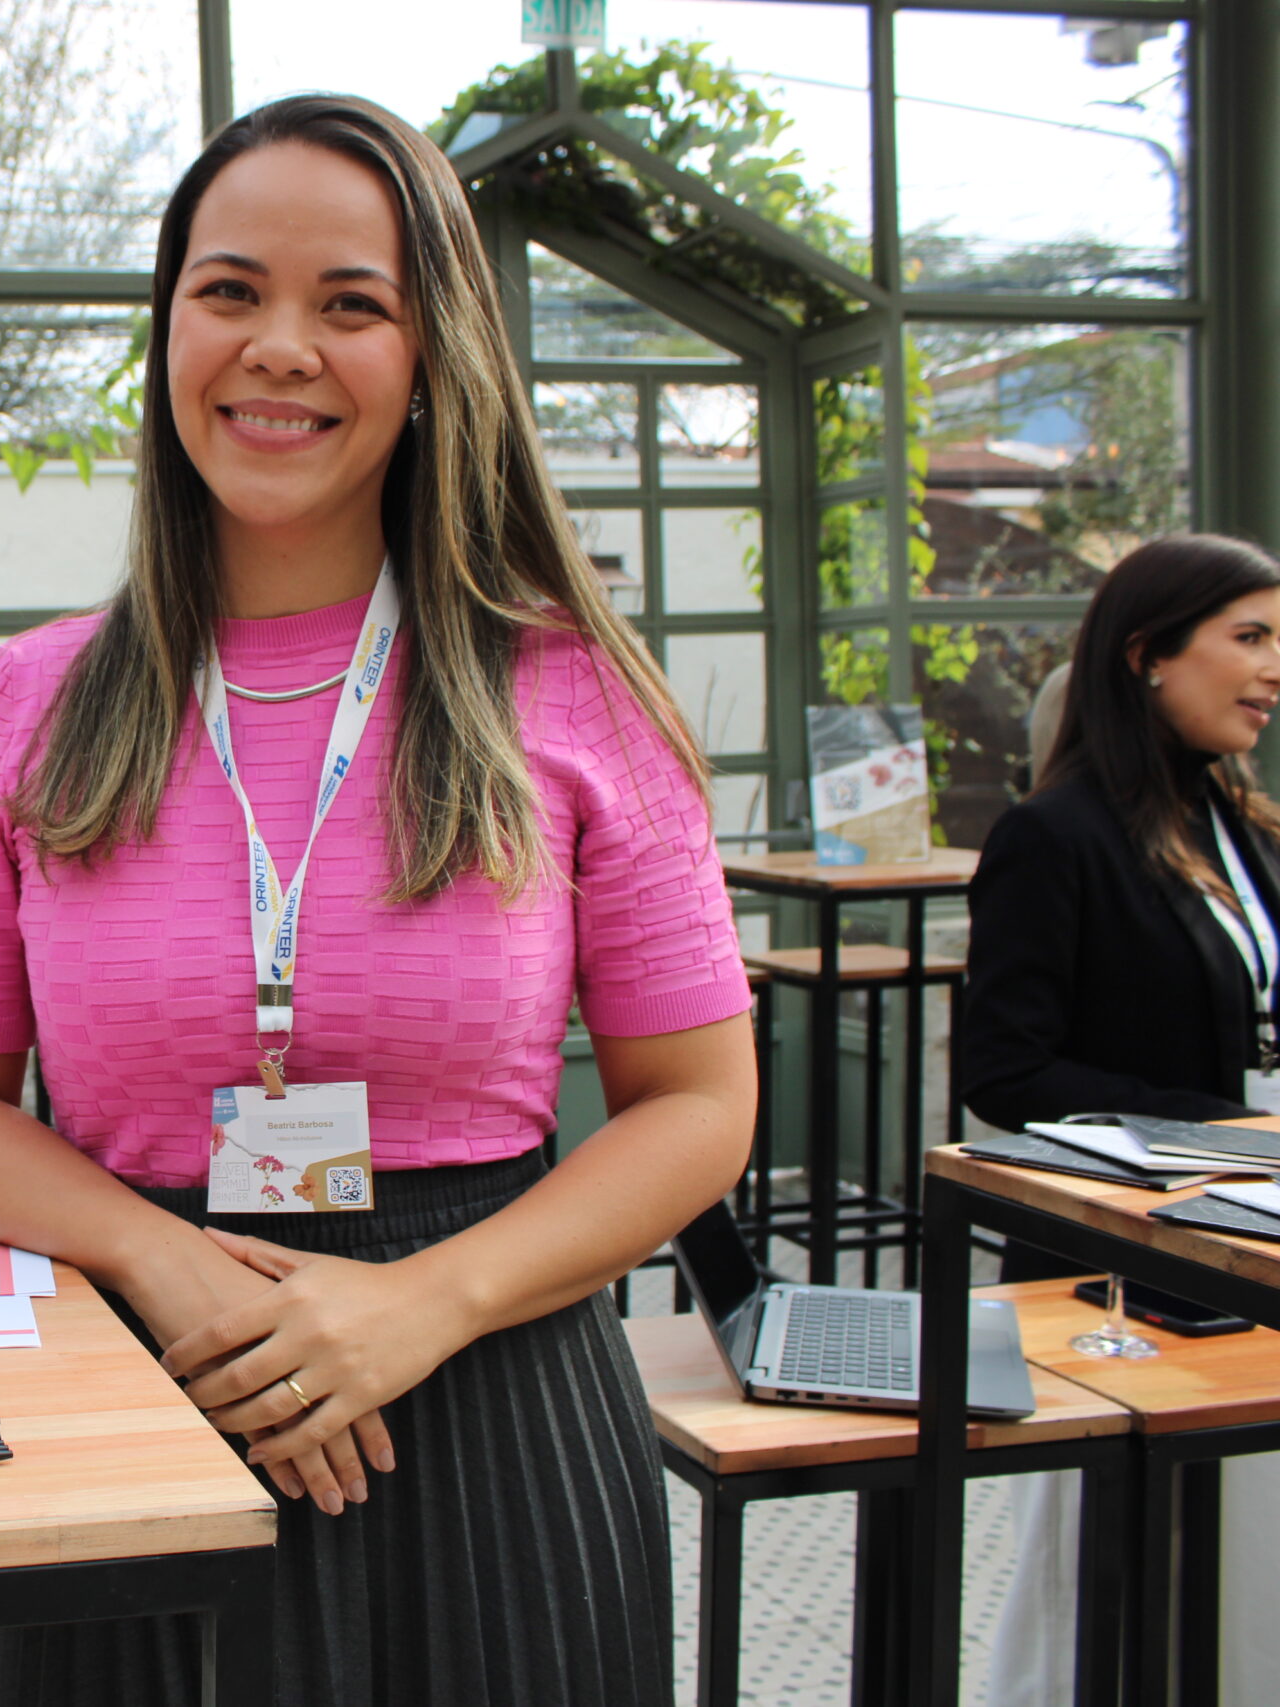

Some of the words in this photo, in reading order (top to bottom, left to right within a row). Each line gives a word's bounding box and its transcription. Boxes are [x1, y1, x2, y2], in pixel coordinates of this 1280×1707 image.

[364, 627, 391, 687] ORINTER
[253, 841, 268, 912] ORINTER
[278, 887, 299, 959] ORINTER
[267, 1121, 297, 1130] Beatriz
[298, 1120, 334, 1129] Barbosa
